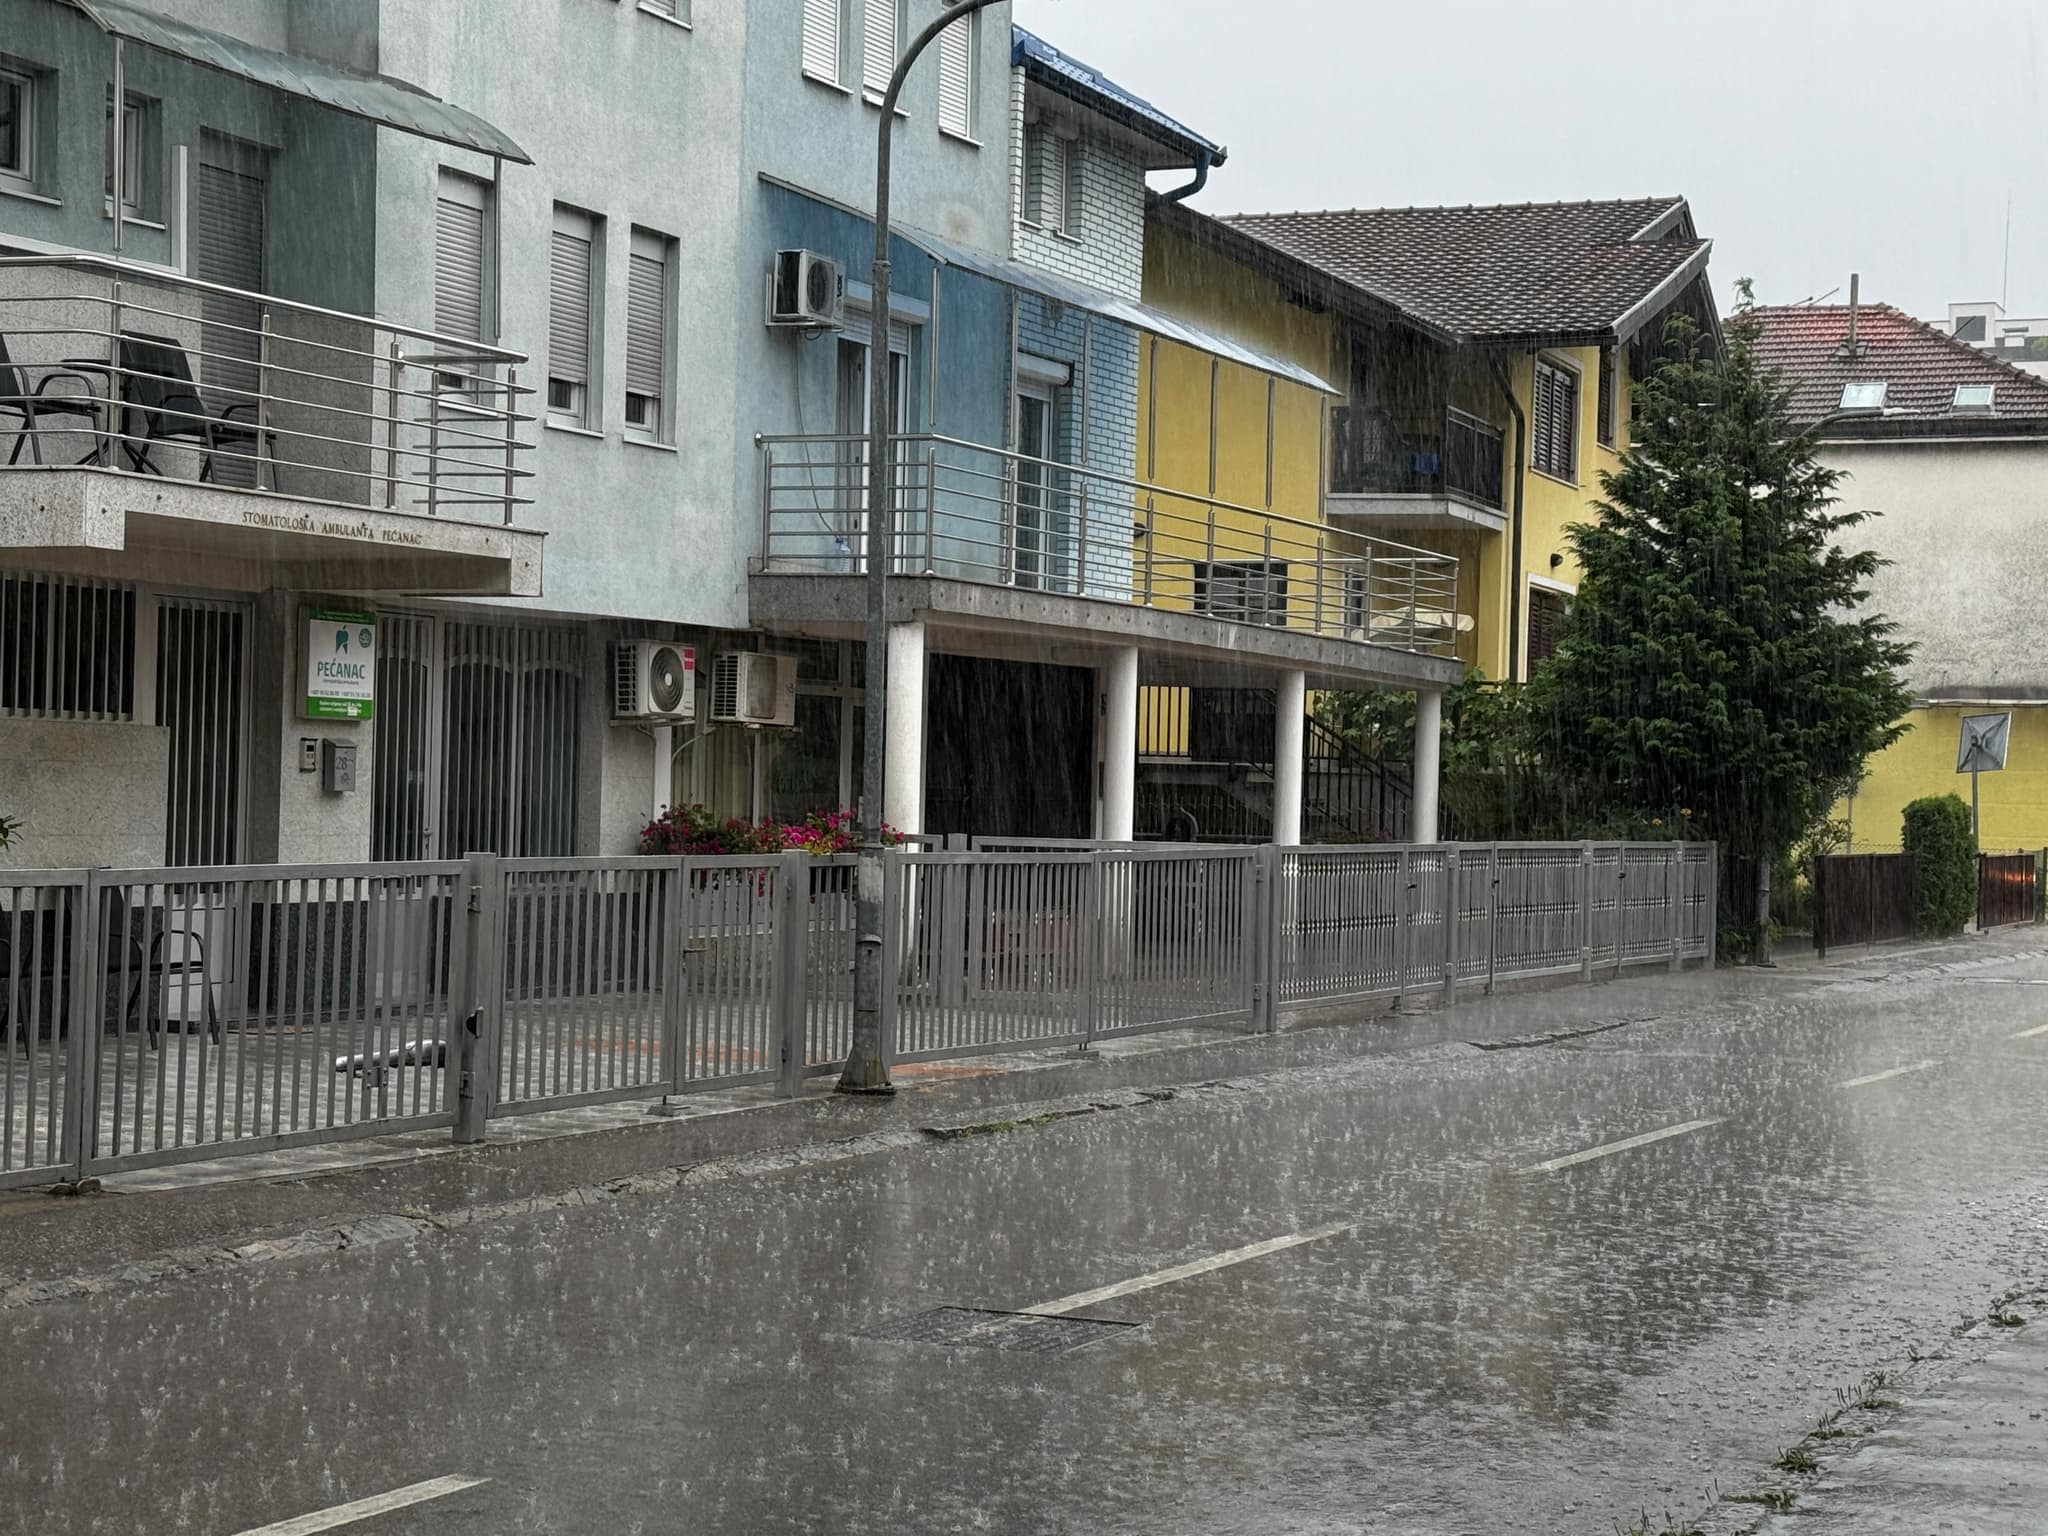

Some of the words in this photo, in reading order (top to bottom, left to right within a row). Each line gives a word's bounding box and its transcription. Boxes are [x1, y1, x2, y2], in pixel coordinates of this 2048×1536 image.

[242, 511, 315, 532] STOMATOLOŠKA
[321, 524, 374, 540] AMBULANTA
[382, 530, 422, 544] PEĆANAC
[317, 658, 366, 679] PEĆANAC
